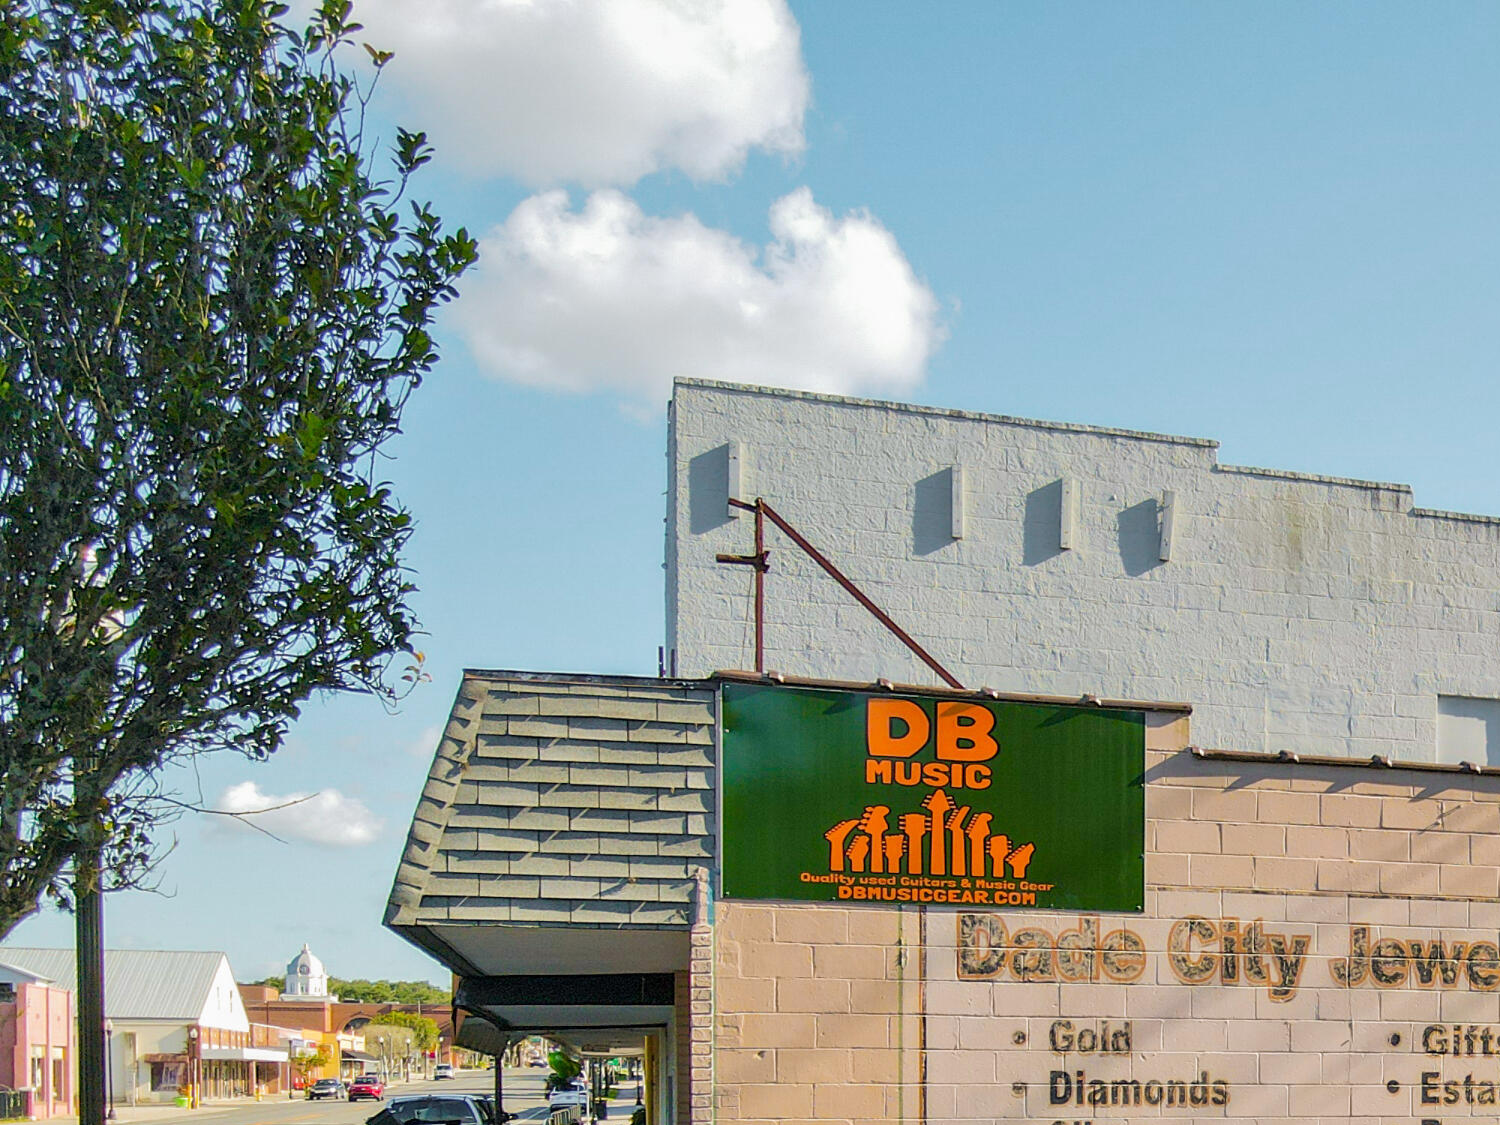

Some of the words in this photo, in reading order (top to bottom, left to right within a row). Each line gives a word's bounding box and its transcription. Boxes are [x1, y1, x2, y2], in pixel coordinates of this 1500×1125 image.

[866, 697, 999, 762] DB
[865, 759, 993, 790] MUSIC
[800, 872, 855, 885] Quality
[859, 876, 897, 886] used
[900, 876, 957, 888] Guitars
[960, 878, 972, 889] &
[975, 879, 1016, 891] Music
[1019, 881, 1055, 891] Gear
[837, 885, 1036, 905] DBMUSICGEAR.COM
[956, 910, 1147, 982] Dade
[1167, 915, 1312, 1004] City
[1049, 1019, 1133, 1056] Gold
[1049, 1070, 1231, 1108] Diamonds
